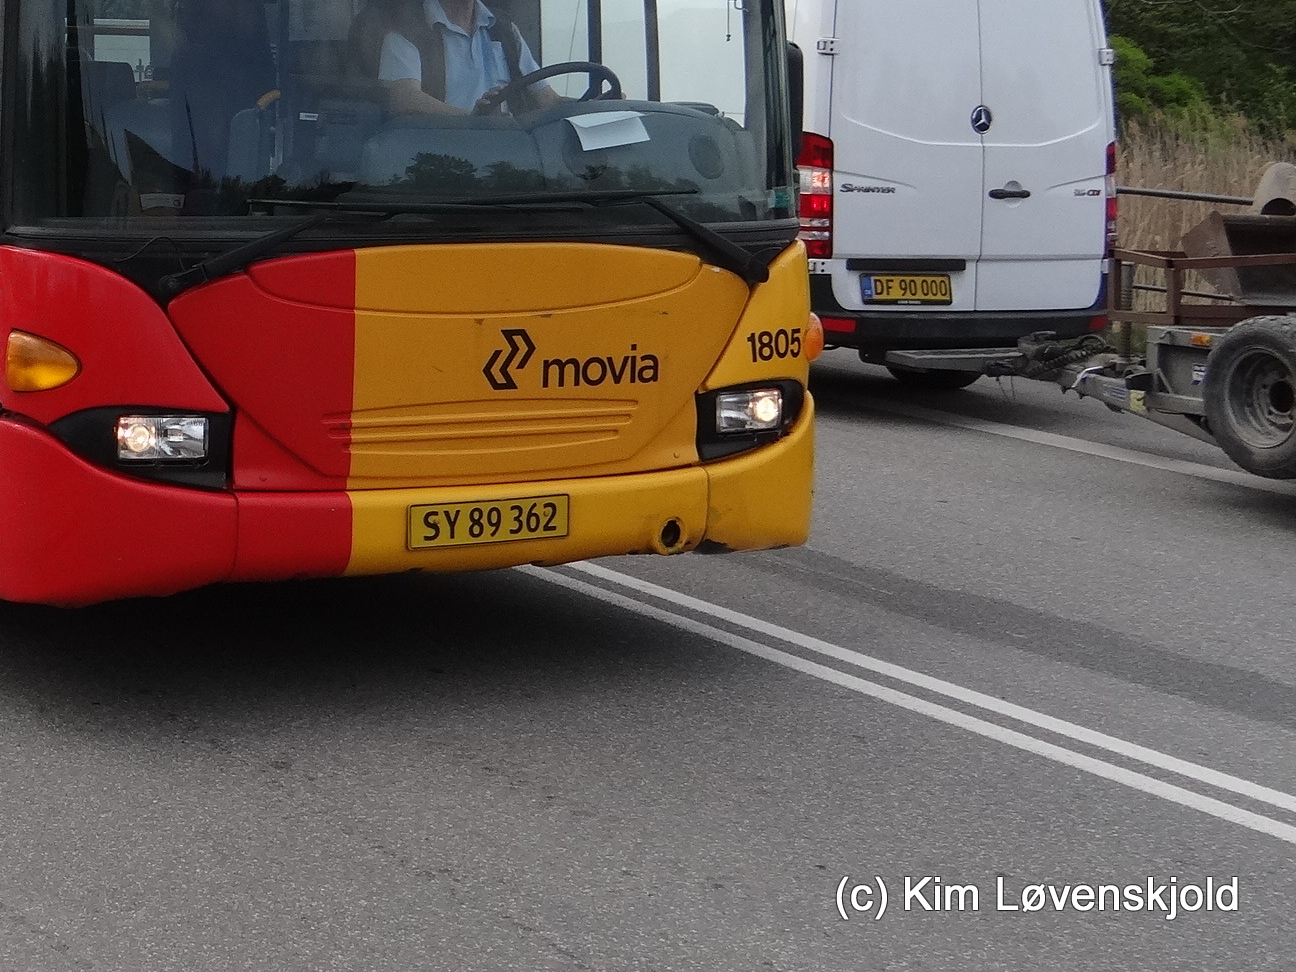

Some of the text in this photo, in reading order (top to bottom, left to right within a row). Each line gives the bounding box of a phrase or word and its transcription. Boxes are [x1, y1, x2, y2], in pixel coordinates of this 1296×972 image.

[873, 278, 948, 297] DF 90 000
[746, 327, 802, 363] 1805
[541, 343, 660, 389] movia
[422, 501, 558, 542] SY 89 362
